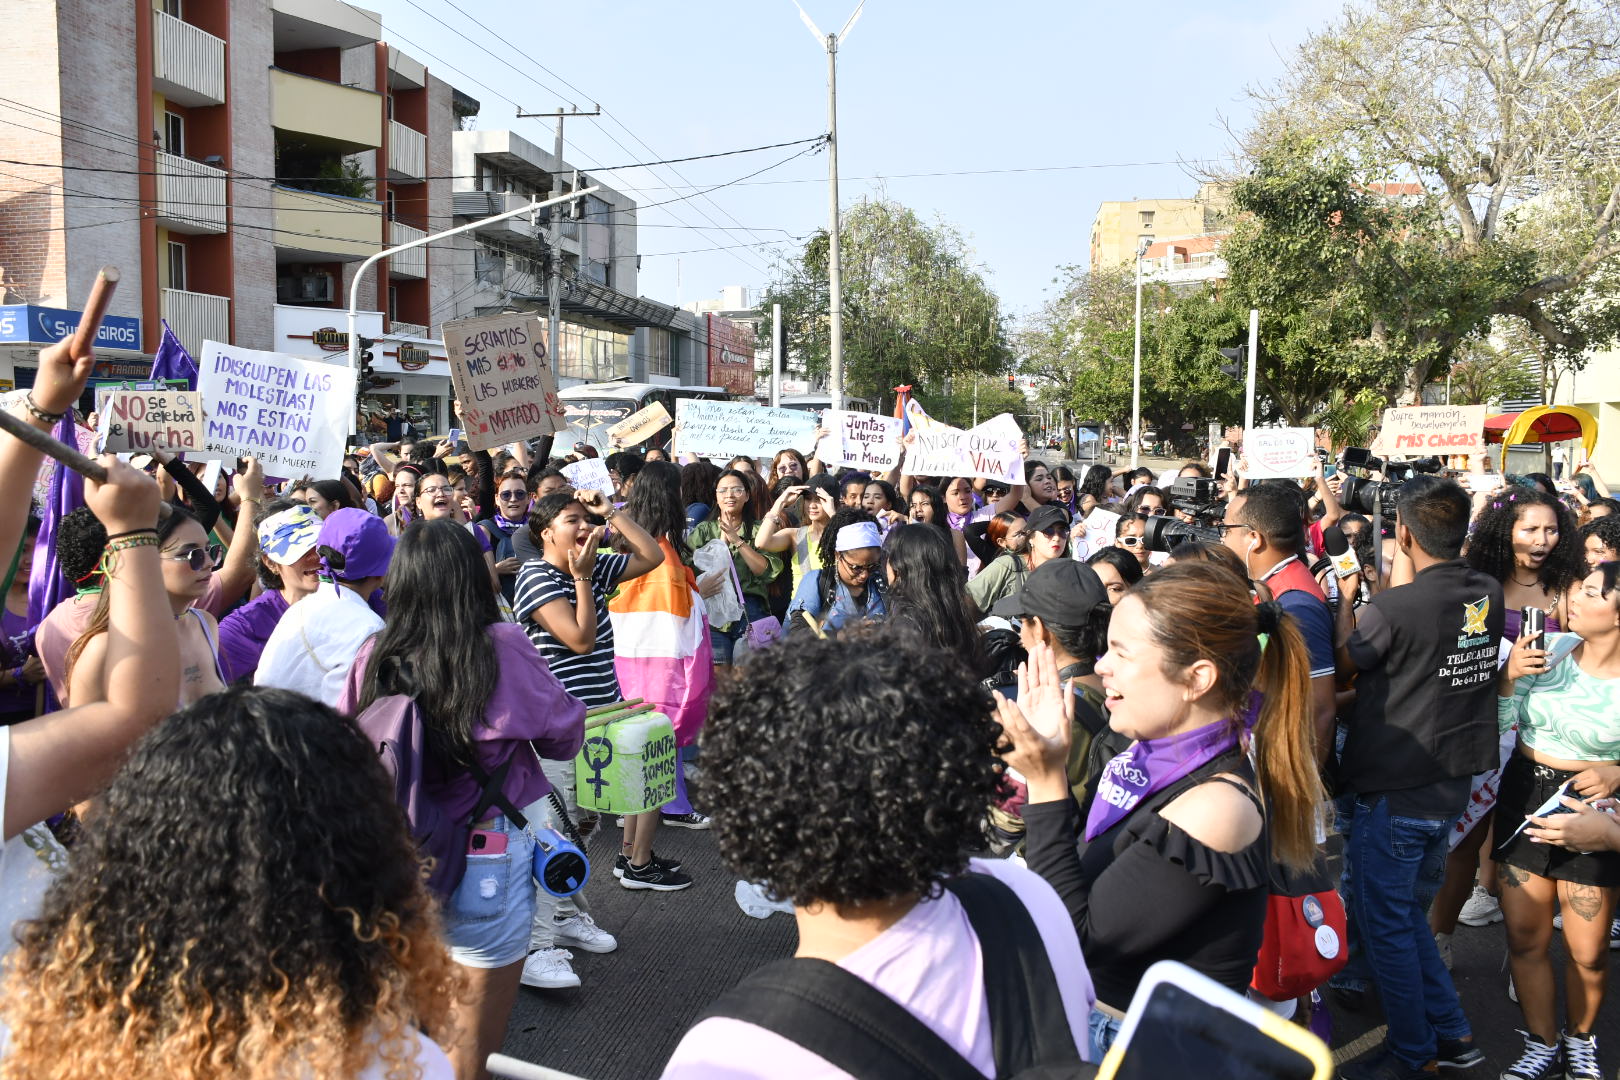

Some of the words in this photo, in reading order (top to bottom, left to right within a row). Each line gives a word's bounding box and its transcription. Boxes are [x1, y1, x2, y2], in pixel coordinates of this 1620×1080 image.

[465, 327, 527, 355] SERIAMOS
[214, 352, 298, 389] ¡DISCULPEN
[304, 373, 332, 392] LAS
[467, 356, 492, 377] MAS
[225, 378, 315, 416] MOLESTIAS!
[473, 382, 498, 401] LAS
[105, 396, 146, 420] NO
[145, 410, 195, 423] celebra
[217, 401, 248, 421] NOS
[489, 402, 540, 435] MATADO
[846, 414, 886, 433] Juntas
[128, 422, 194, 449] lucha
[849, 428, 884, 443] Libres
[256, 452, 266, 460] DE
[269, 453, 279, 463] LA
[282, 457, 317, 469] MUERTE
[862, 451, 892, 465] Miedo
[1438, 668, 1451, 677] De
[1451, 678, 1464, 686] De
